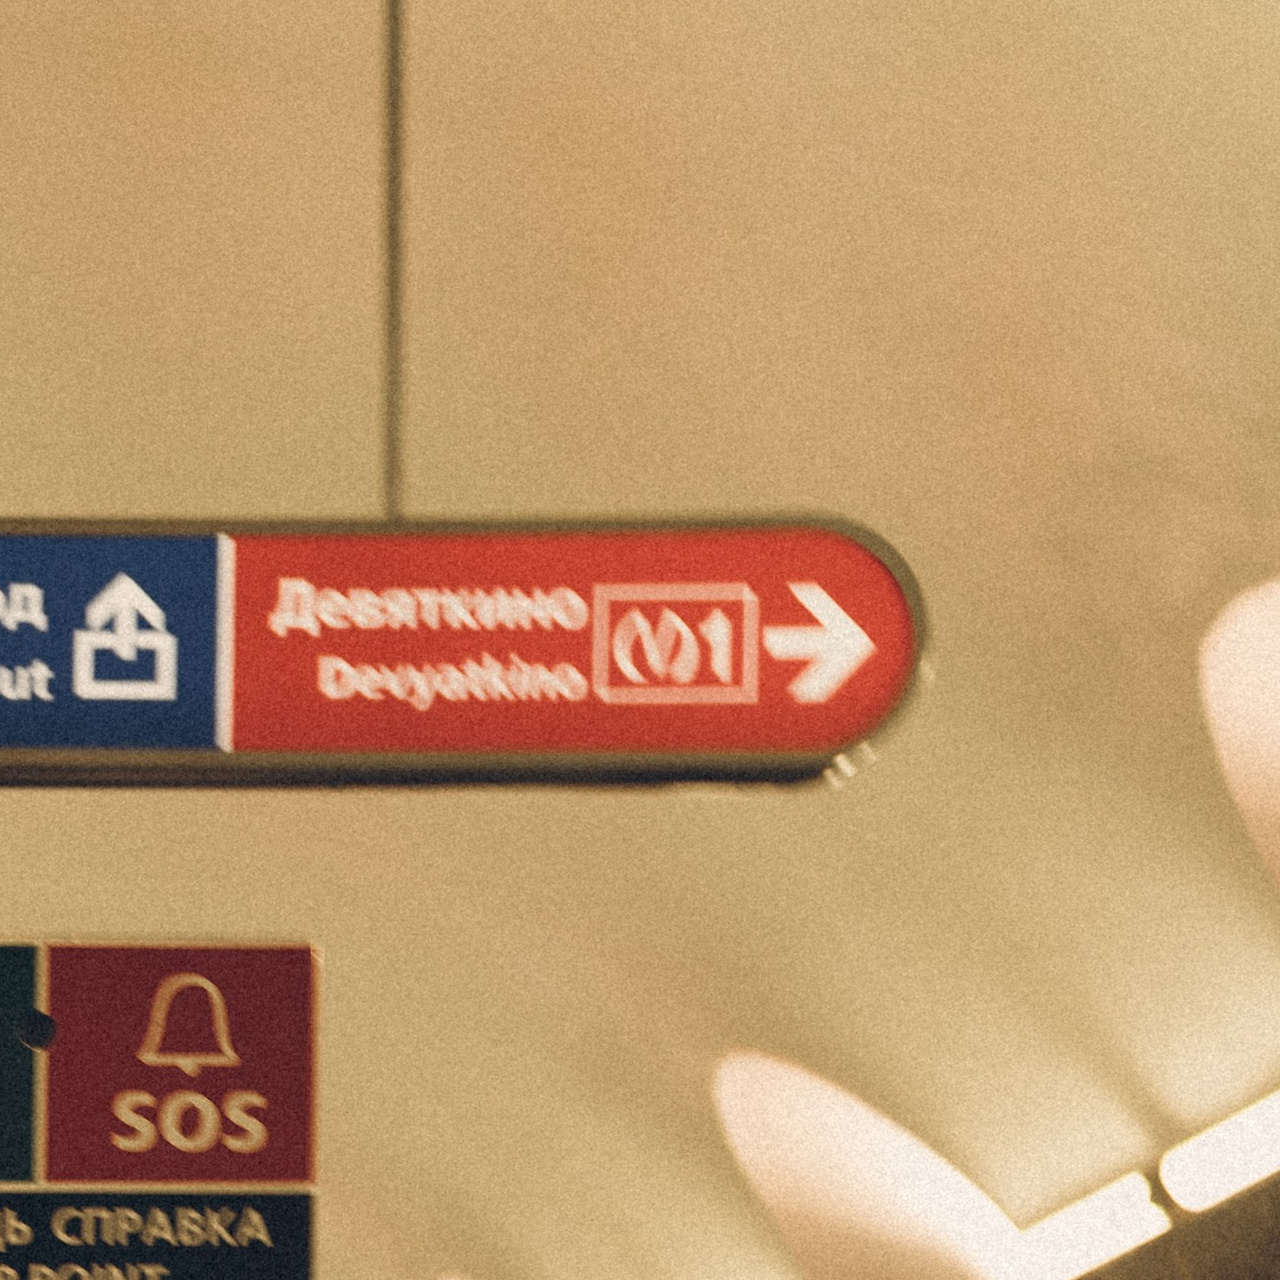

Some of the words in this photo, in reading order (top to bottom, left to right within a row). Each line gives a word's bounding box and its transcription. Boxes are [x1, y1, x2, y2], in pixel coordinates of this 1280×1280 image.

[269, 577, 589, 638] Девяткино
[318, 652, 589, 711] Devyatkino
[110, 1090, 269, 1154] SOS
[50, 1206, 274, 1247] СПРАВКА
